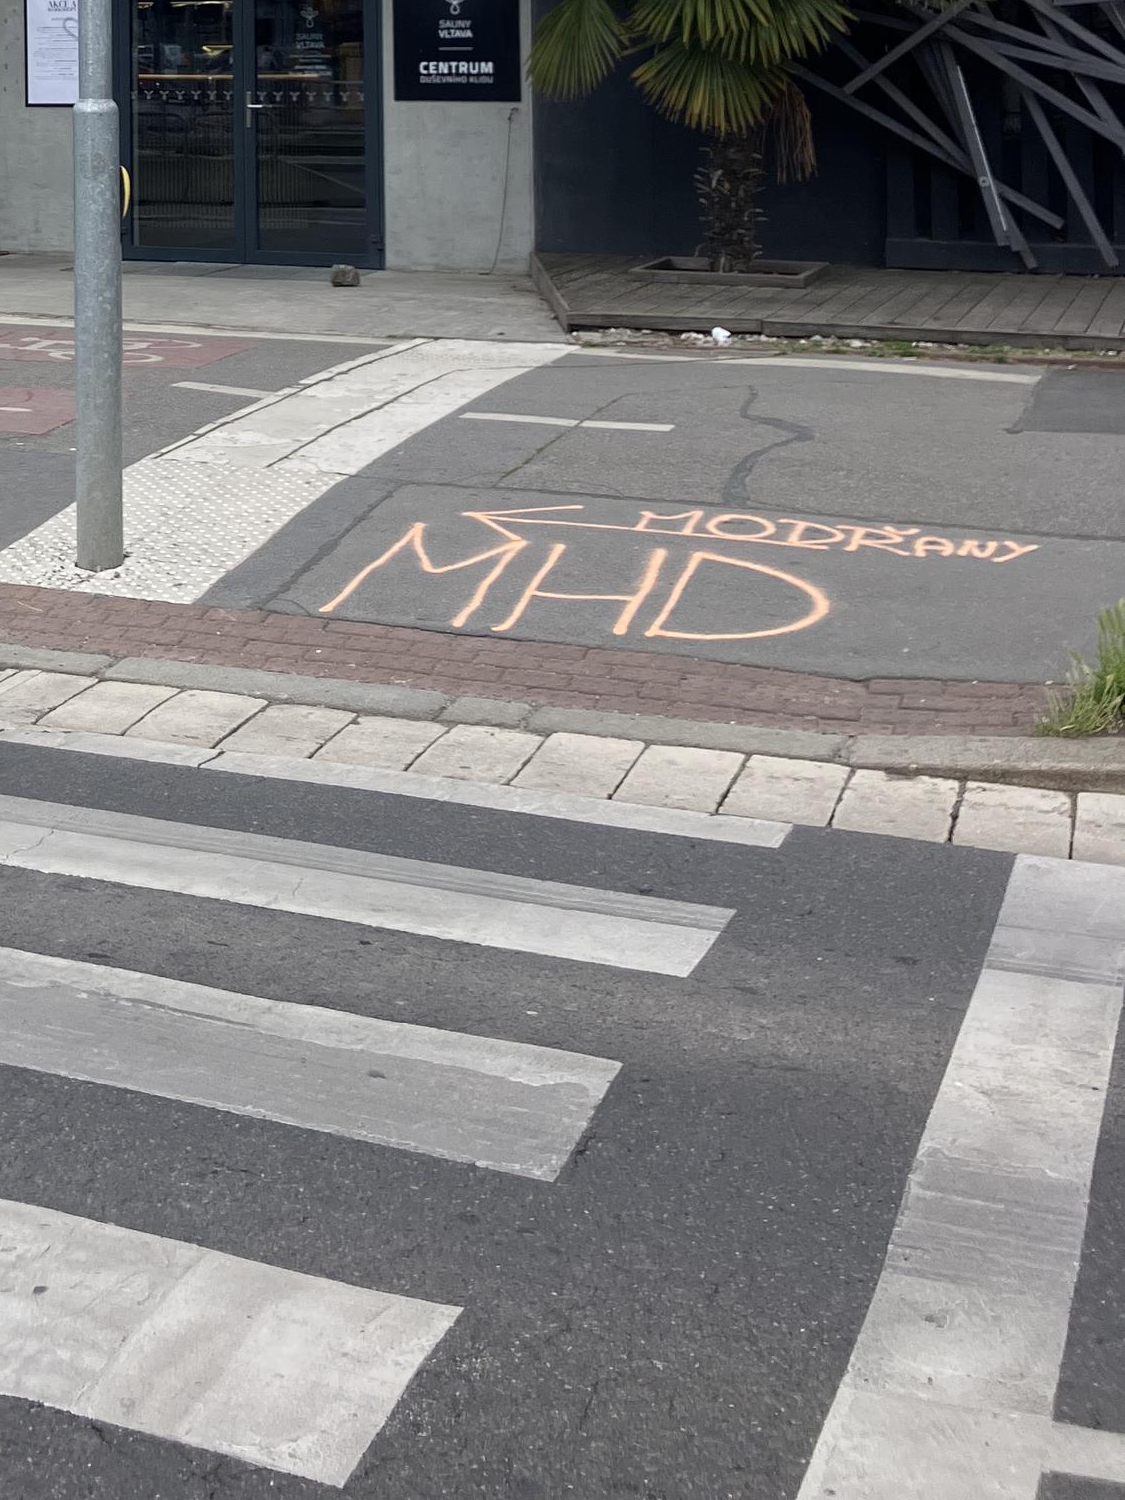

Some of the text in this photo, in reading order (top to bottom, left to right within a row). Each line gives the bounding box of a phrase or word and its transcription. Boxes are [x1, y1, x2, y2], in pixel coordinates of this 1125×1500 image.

[438, 29, 473, 38] VLTAVA
[419, 61, 493, 74] CENTRUM
[634, 509, 1040, 563] MODŘANY
[318, 522, 830, 641] MHD
